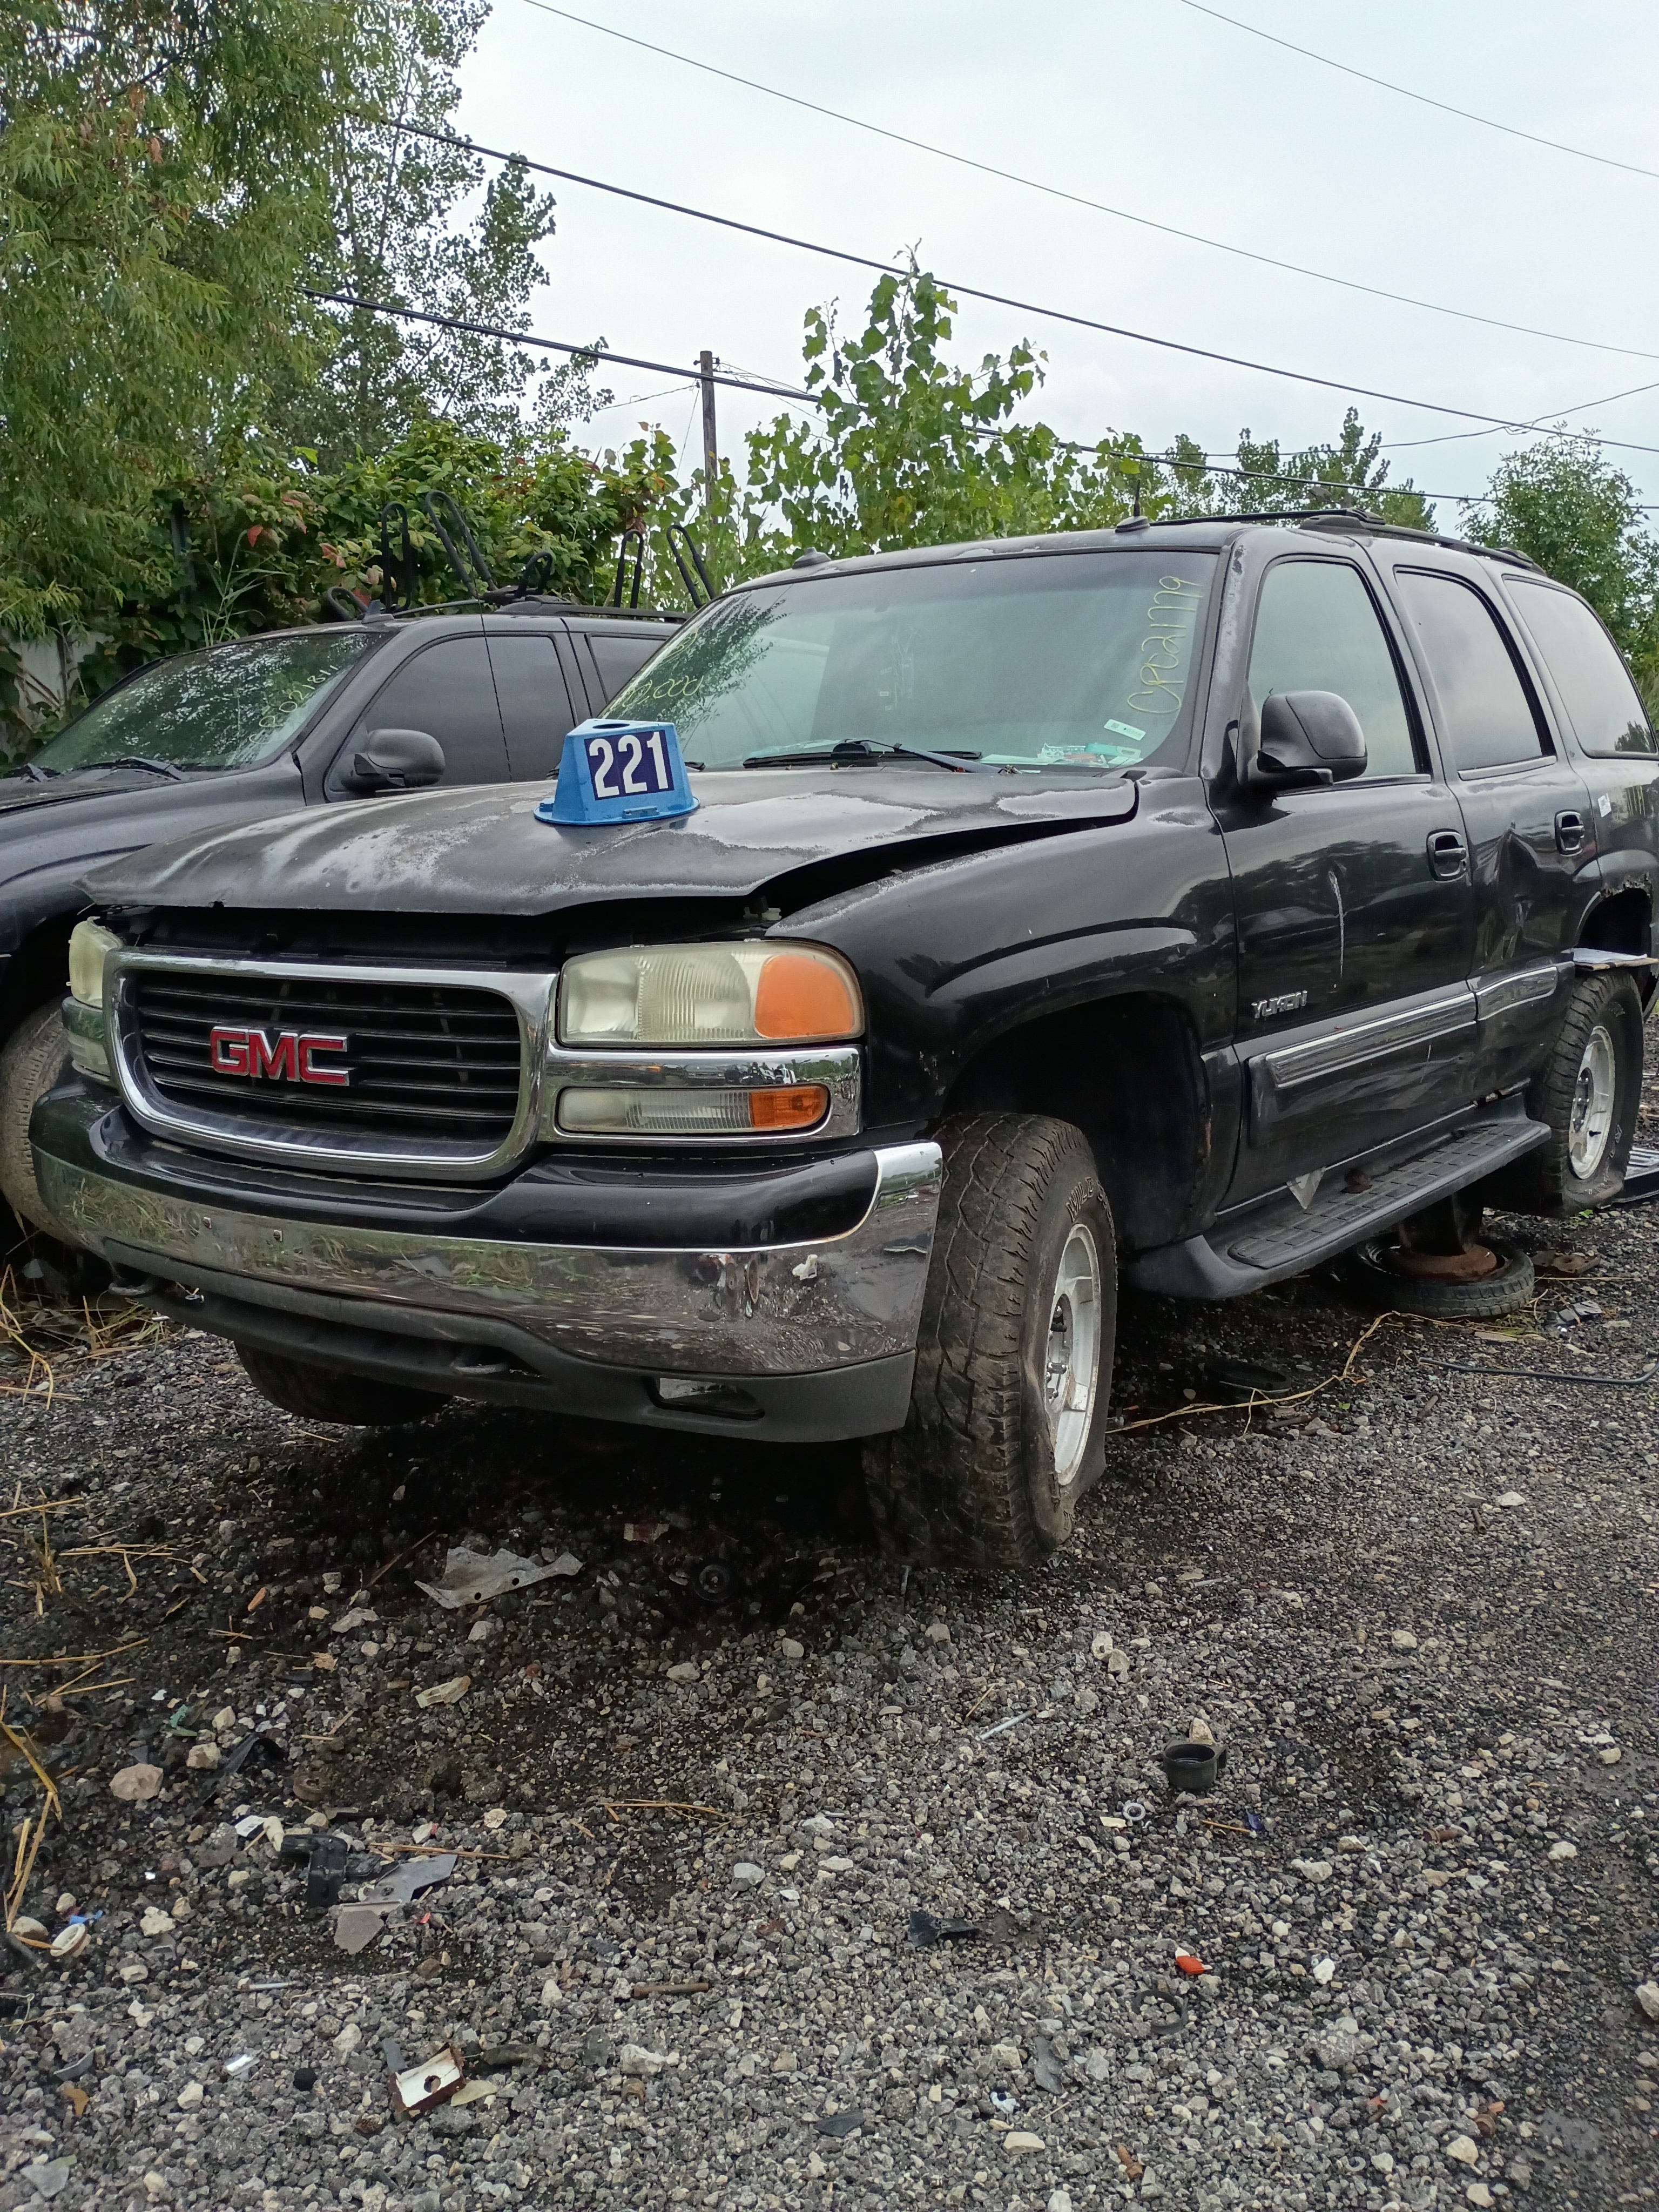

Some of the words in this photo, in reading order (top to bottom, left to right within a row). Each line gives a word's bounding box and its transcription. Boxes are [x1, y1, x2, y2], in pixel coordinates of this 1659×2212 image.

[589, 731, 669, 798] 221
[1251, 990, 1307, 1019] YUKON
[210, 1026, 349, 1087] GMC
[1065, 1176, 1094, 1223] WILD
